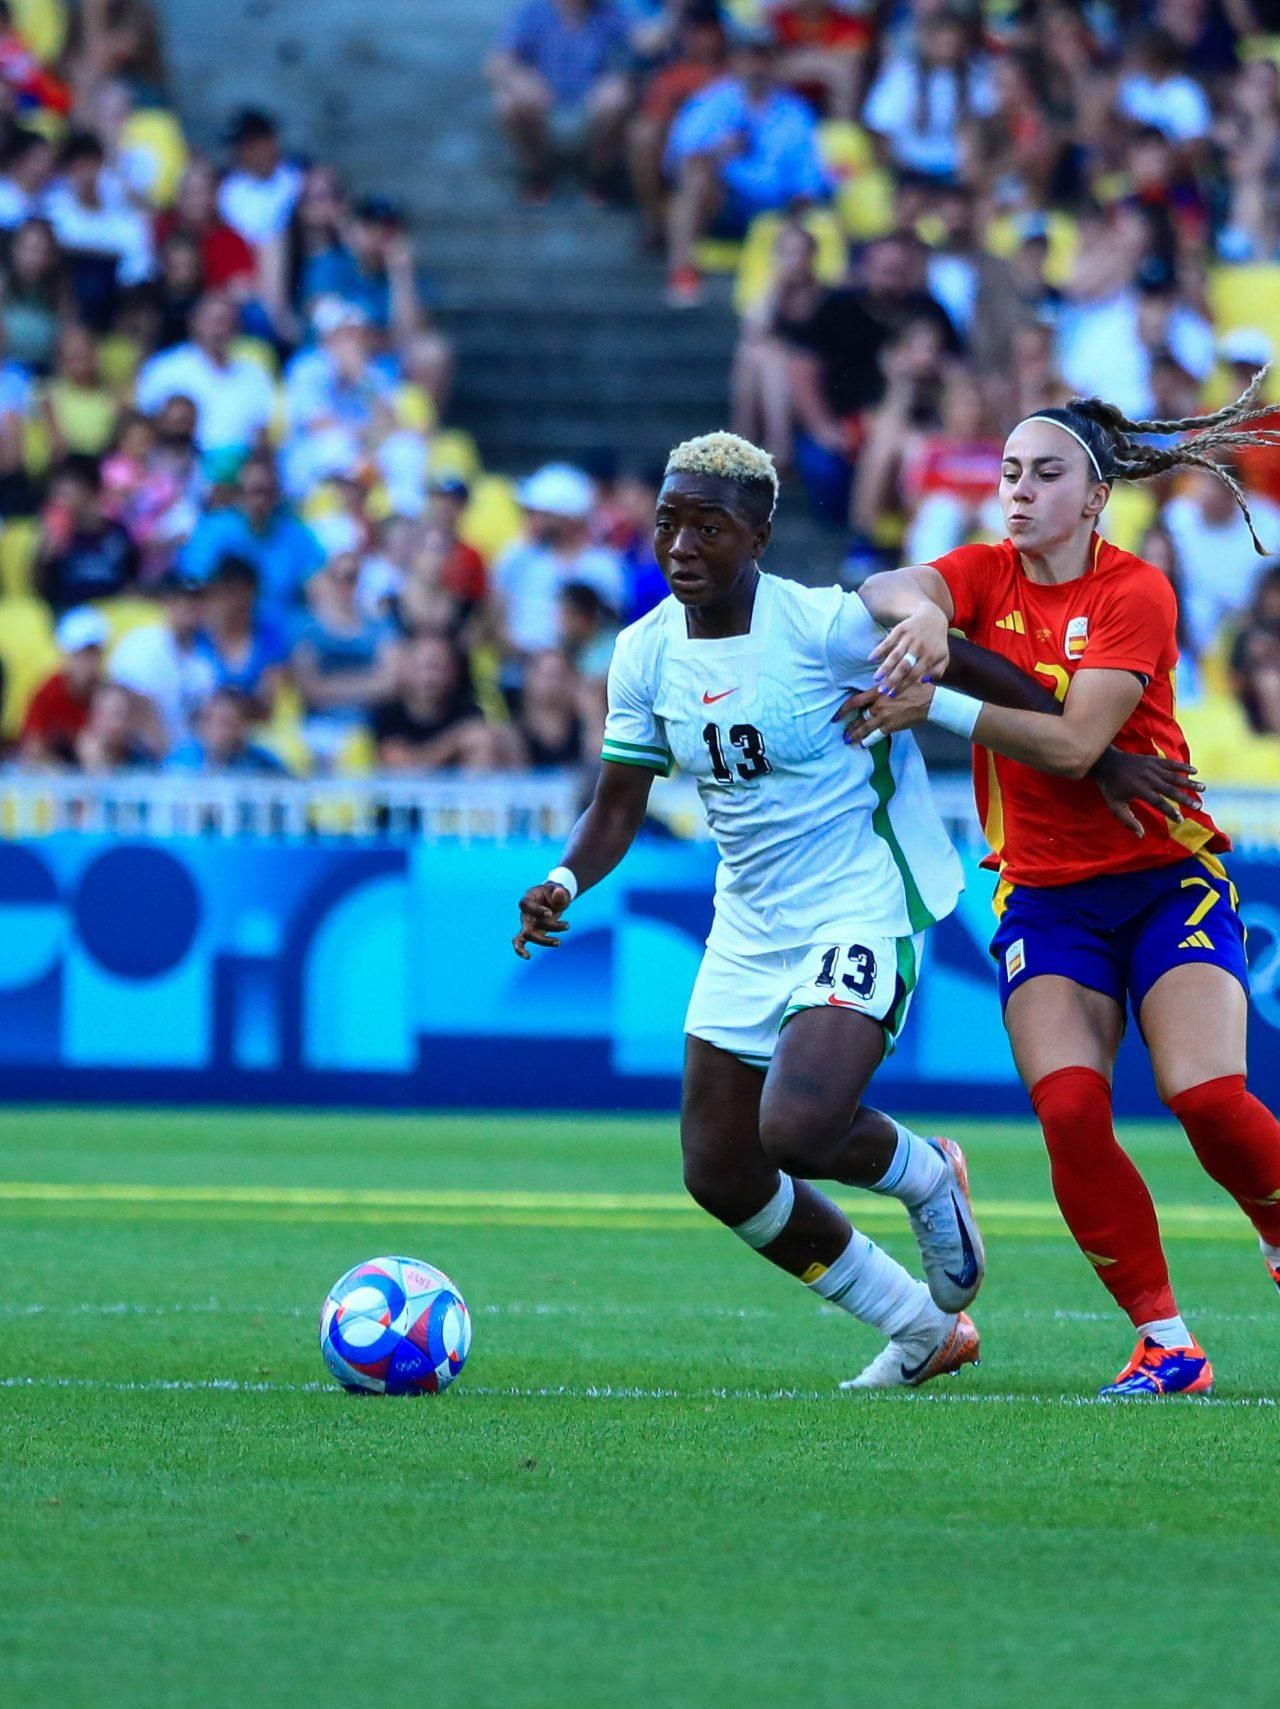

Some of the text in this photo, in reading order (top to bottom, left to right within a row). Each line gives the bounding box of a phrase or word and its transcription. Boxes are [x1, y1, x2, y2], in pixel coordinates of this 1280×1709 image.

[703, 722, 773, 784] 13
[1181, 877, 1220, 926] 7
[815, 944, 877, 1000] 13
